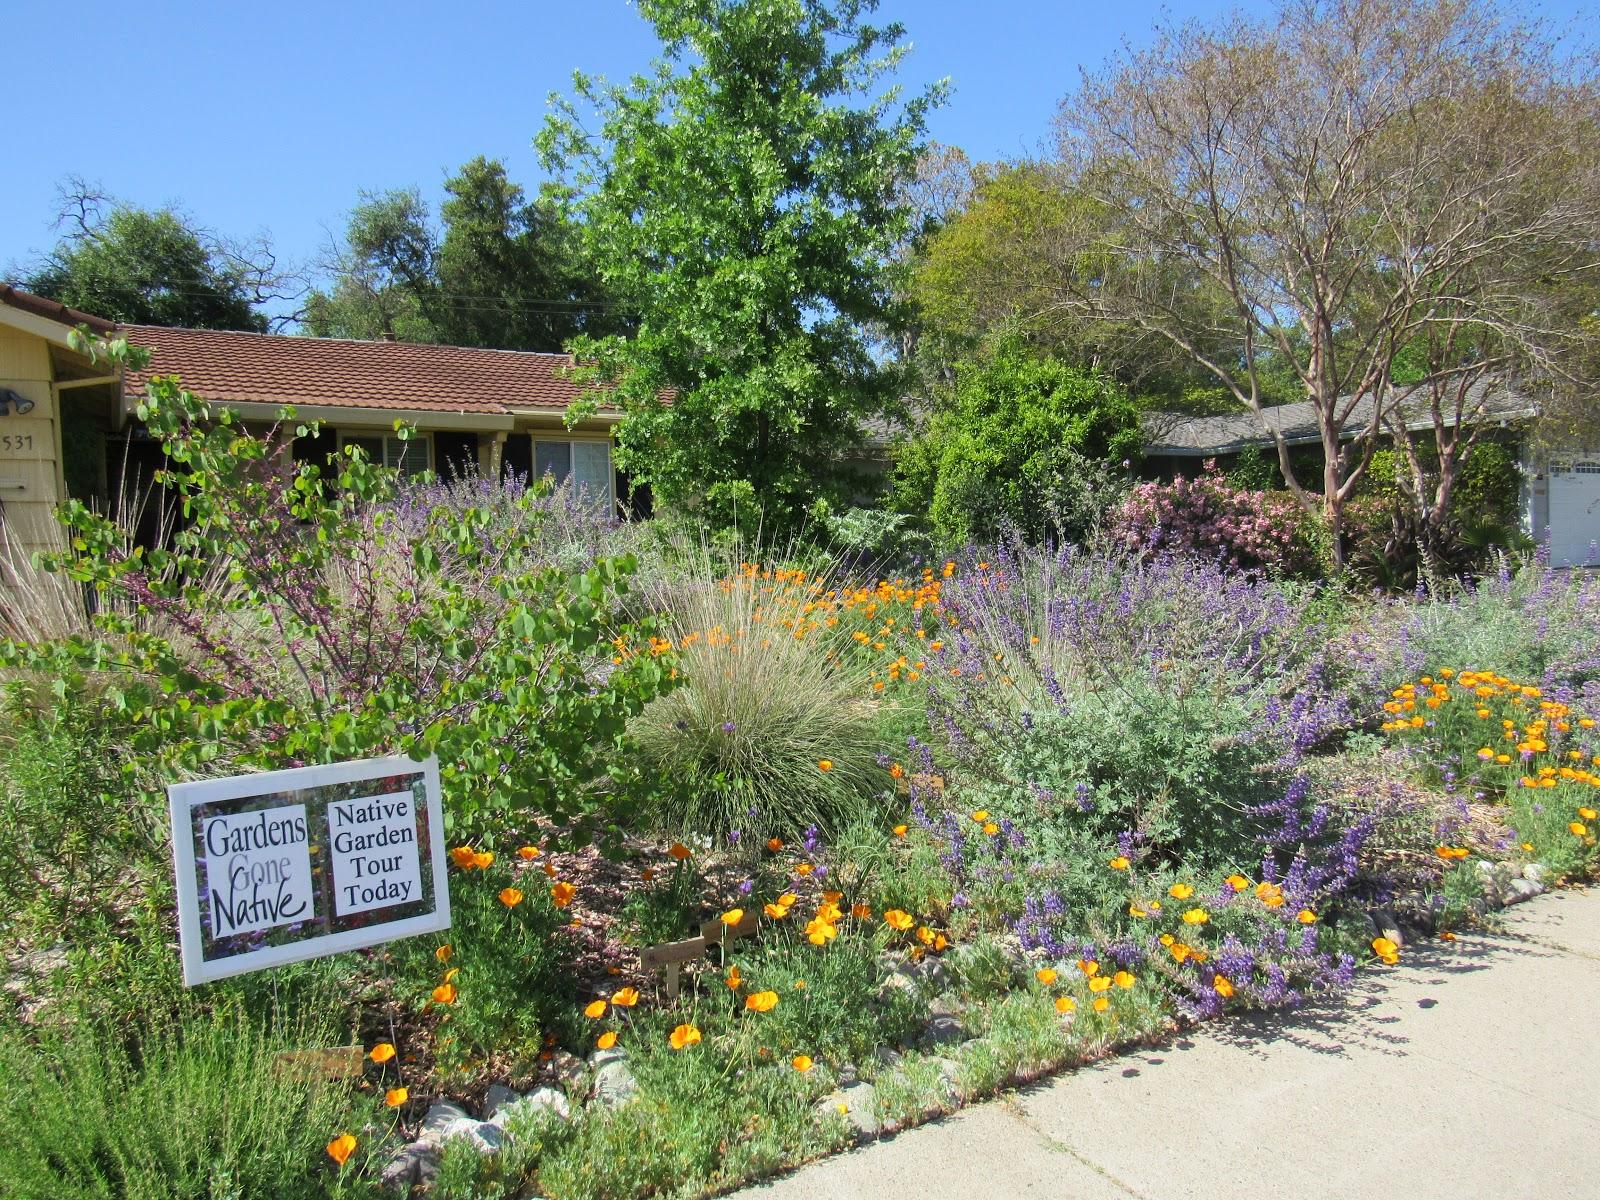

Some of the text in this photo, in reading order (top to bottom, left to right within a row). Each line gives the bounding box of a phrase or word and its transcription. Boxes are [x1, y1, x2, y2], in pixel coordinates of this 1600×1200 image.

[334, 799, 408, 827] Native
[206, 812, 306, 857] Gardens
[334, 825, 414, 854] Garden
[228, 853, 292, 891] Gone
[350, 855, 403, 878] Tour
[211, 866, 307, 936] Native
[344, 879, 412, 907] Today
